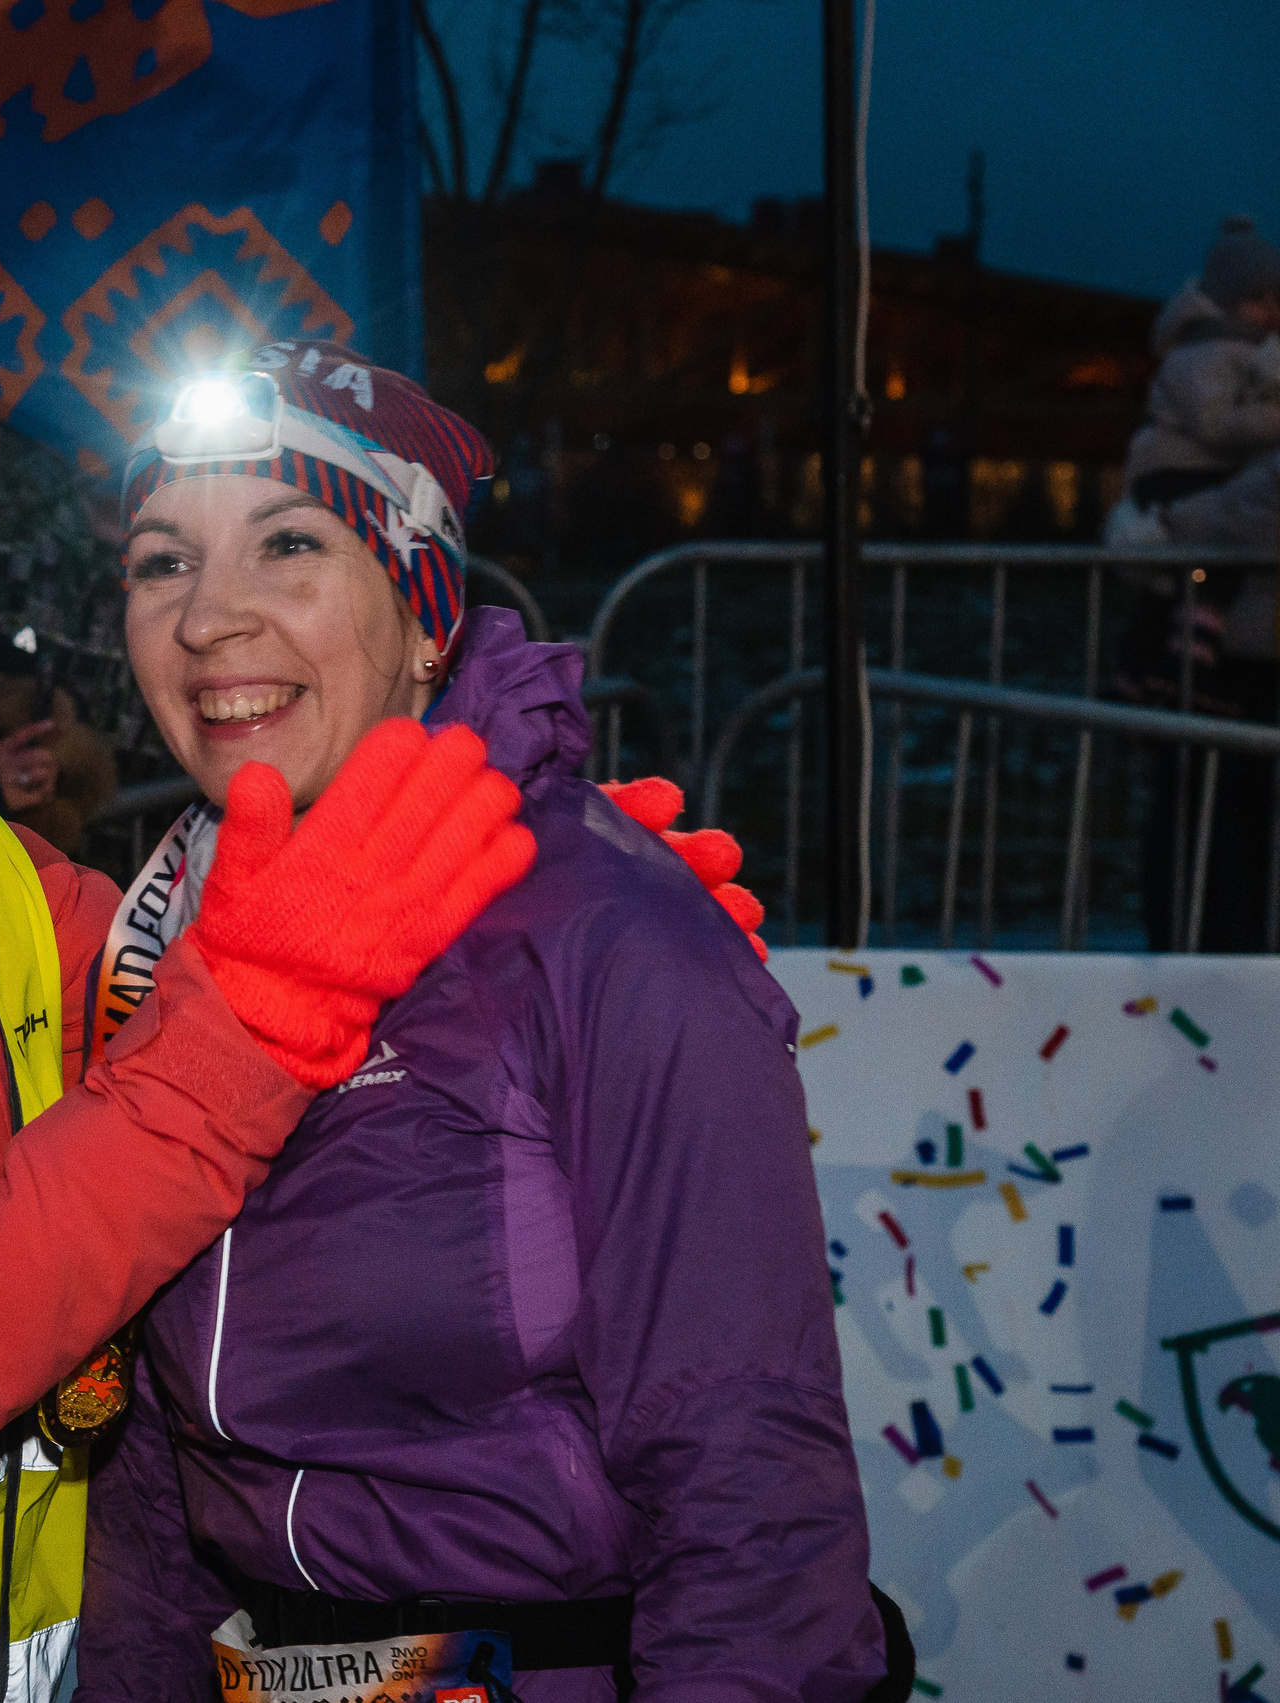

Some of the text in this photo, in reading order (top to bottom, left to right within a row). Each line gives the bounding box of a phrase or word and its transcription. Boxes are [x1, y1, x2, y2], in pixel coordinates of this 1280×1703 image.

[390, 1646, 428, 1659] INVO
[241, 1656, 287, 1691] FOX
[290, 1650, 384, 1691] ULTRA
[392, 1659, 427, 1671] CATI
[391, 1670, 414, 1681] ON
